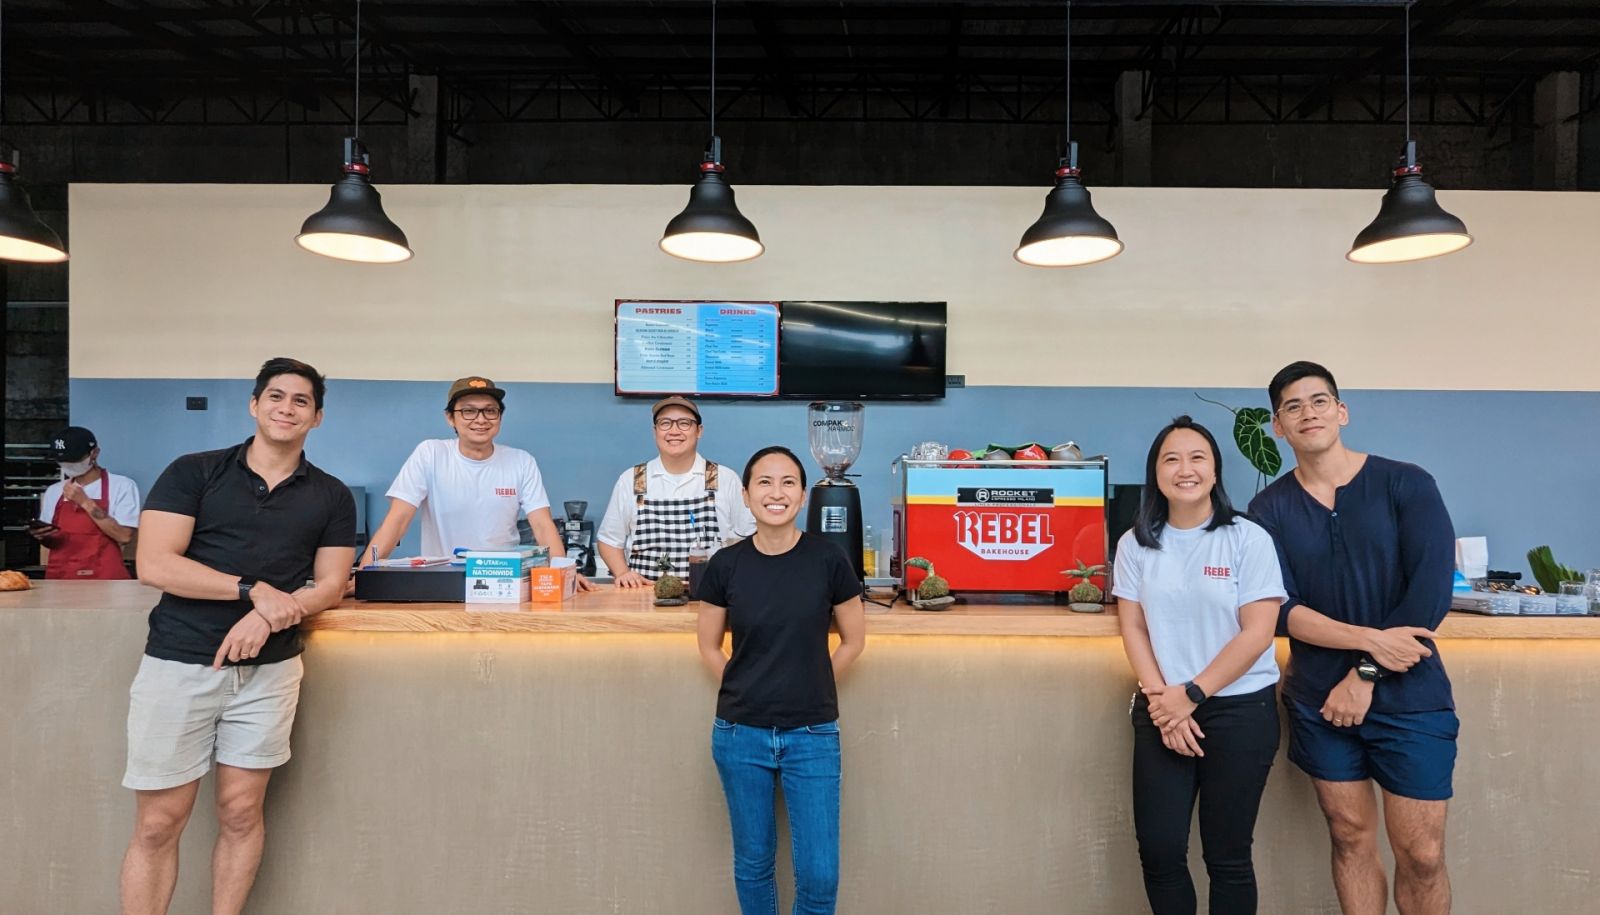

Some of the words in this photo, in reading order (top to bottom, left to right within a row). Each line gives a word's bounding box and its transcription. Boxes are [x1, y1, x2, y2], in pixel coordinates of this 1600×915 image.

[635, 307, 682, 315] PASTRIES
[812, 419, 842, 427] COMPAK
[953, 510, 1054, 548] REBEL
[472, 569, 514, 577] NATIONWIDE
[1203, 566, 1231, 577] REBE
